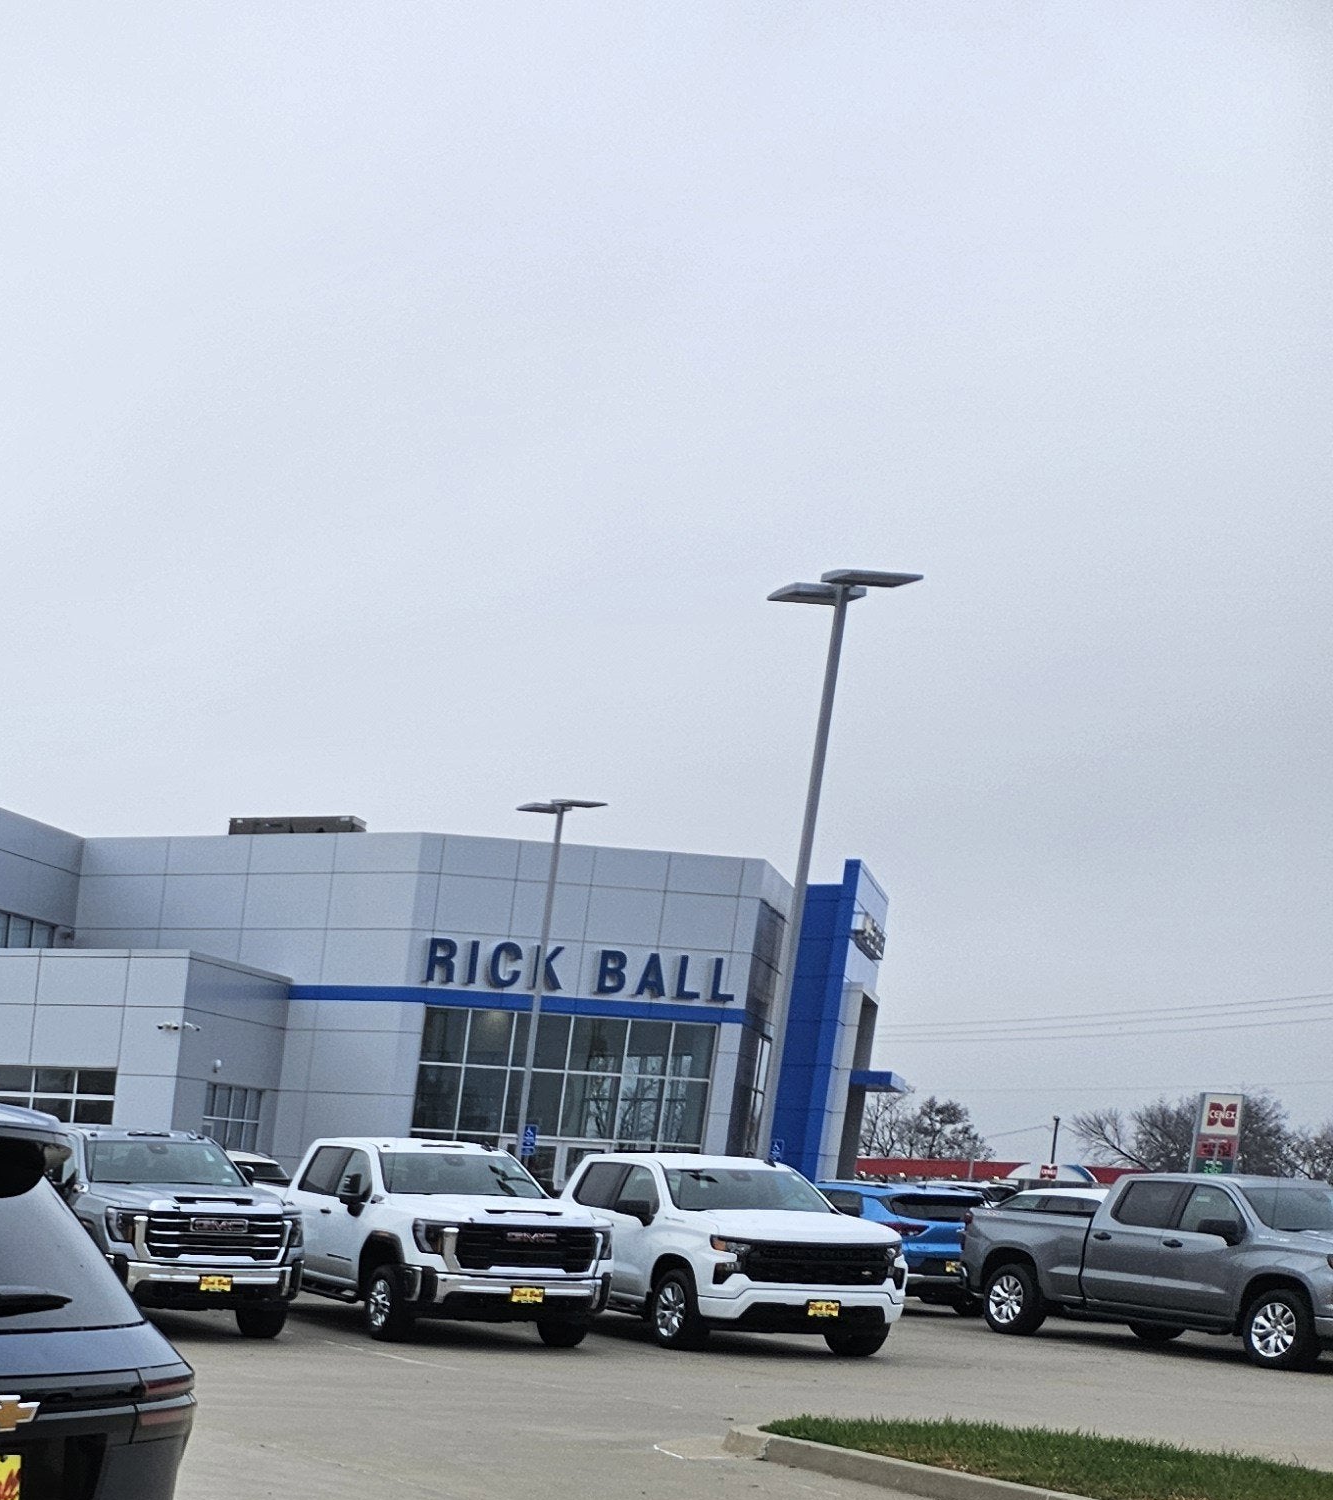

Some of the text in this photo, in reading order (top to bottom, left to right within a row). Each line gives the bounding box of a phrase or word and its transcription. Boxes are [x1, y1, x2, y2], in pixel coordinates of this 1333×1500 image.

[423, 936, 735, 1002] RICK BALL
[506, 1231, 558, 1244] GMC
